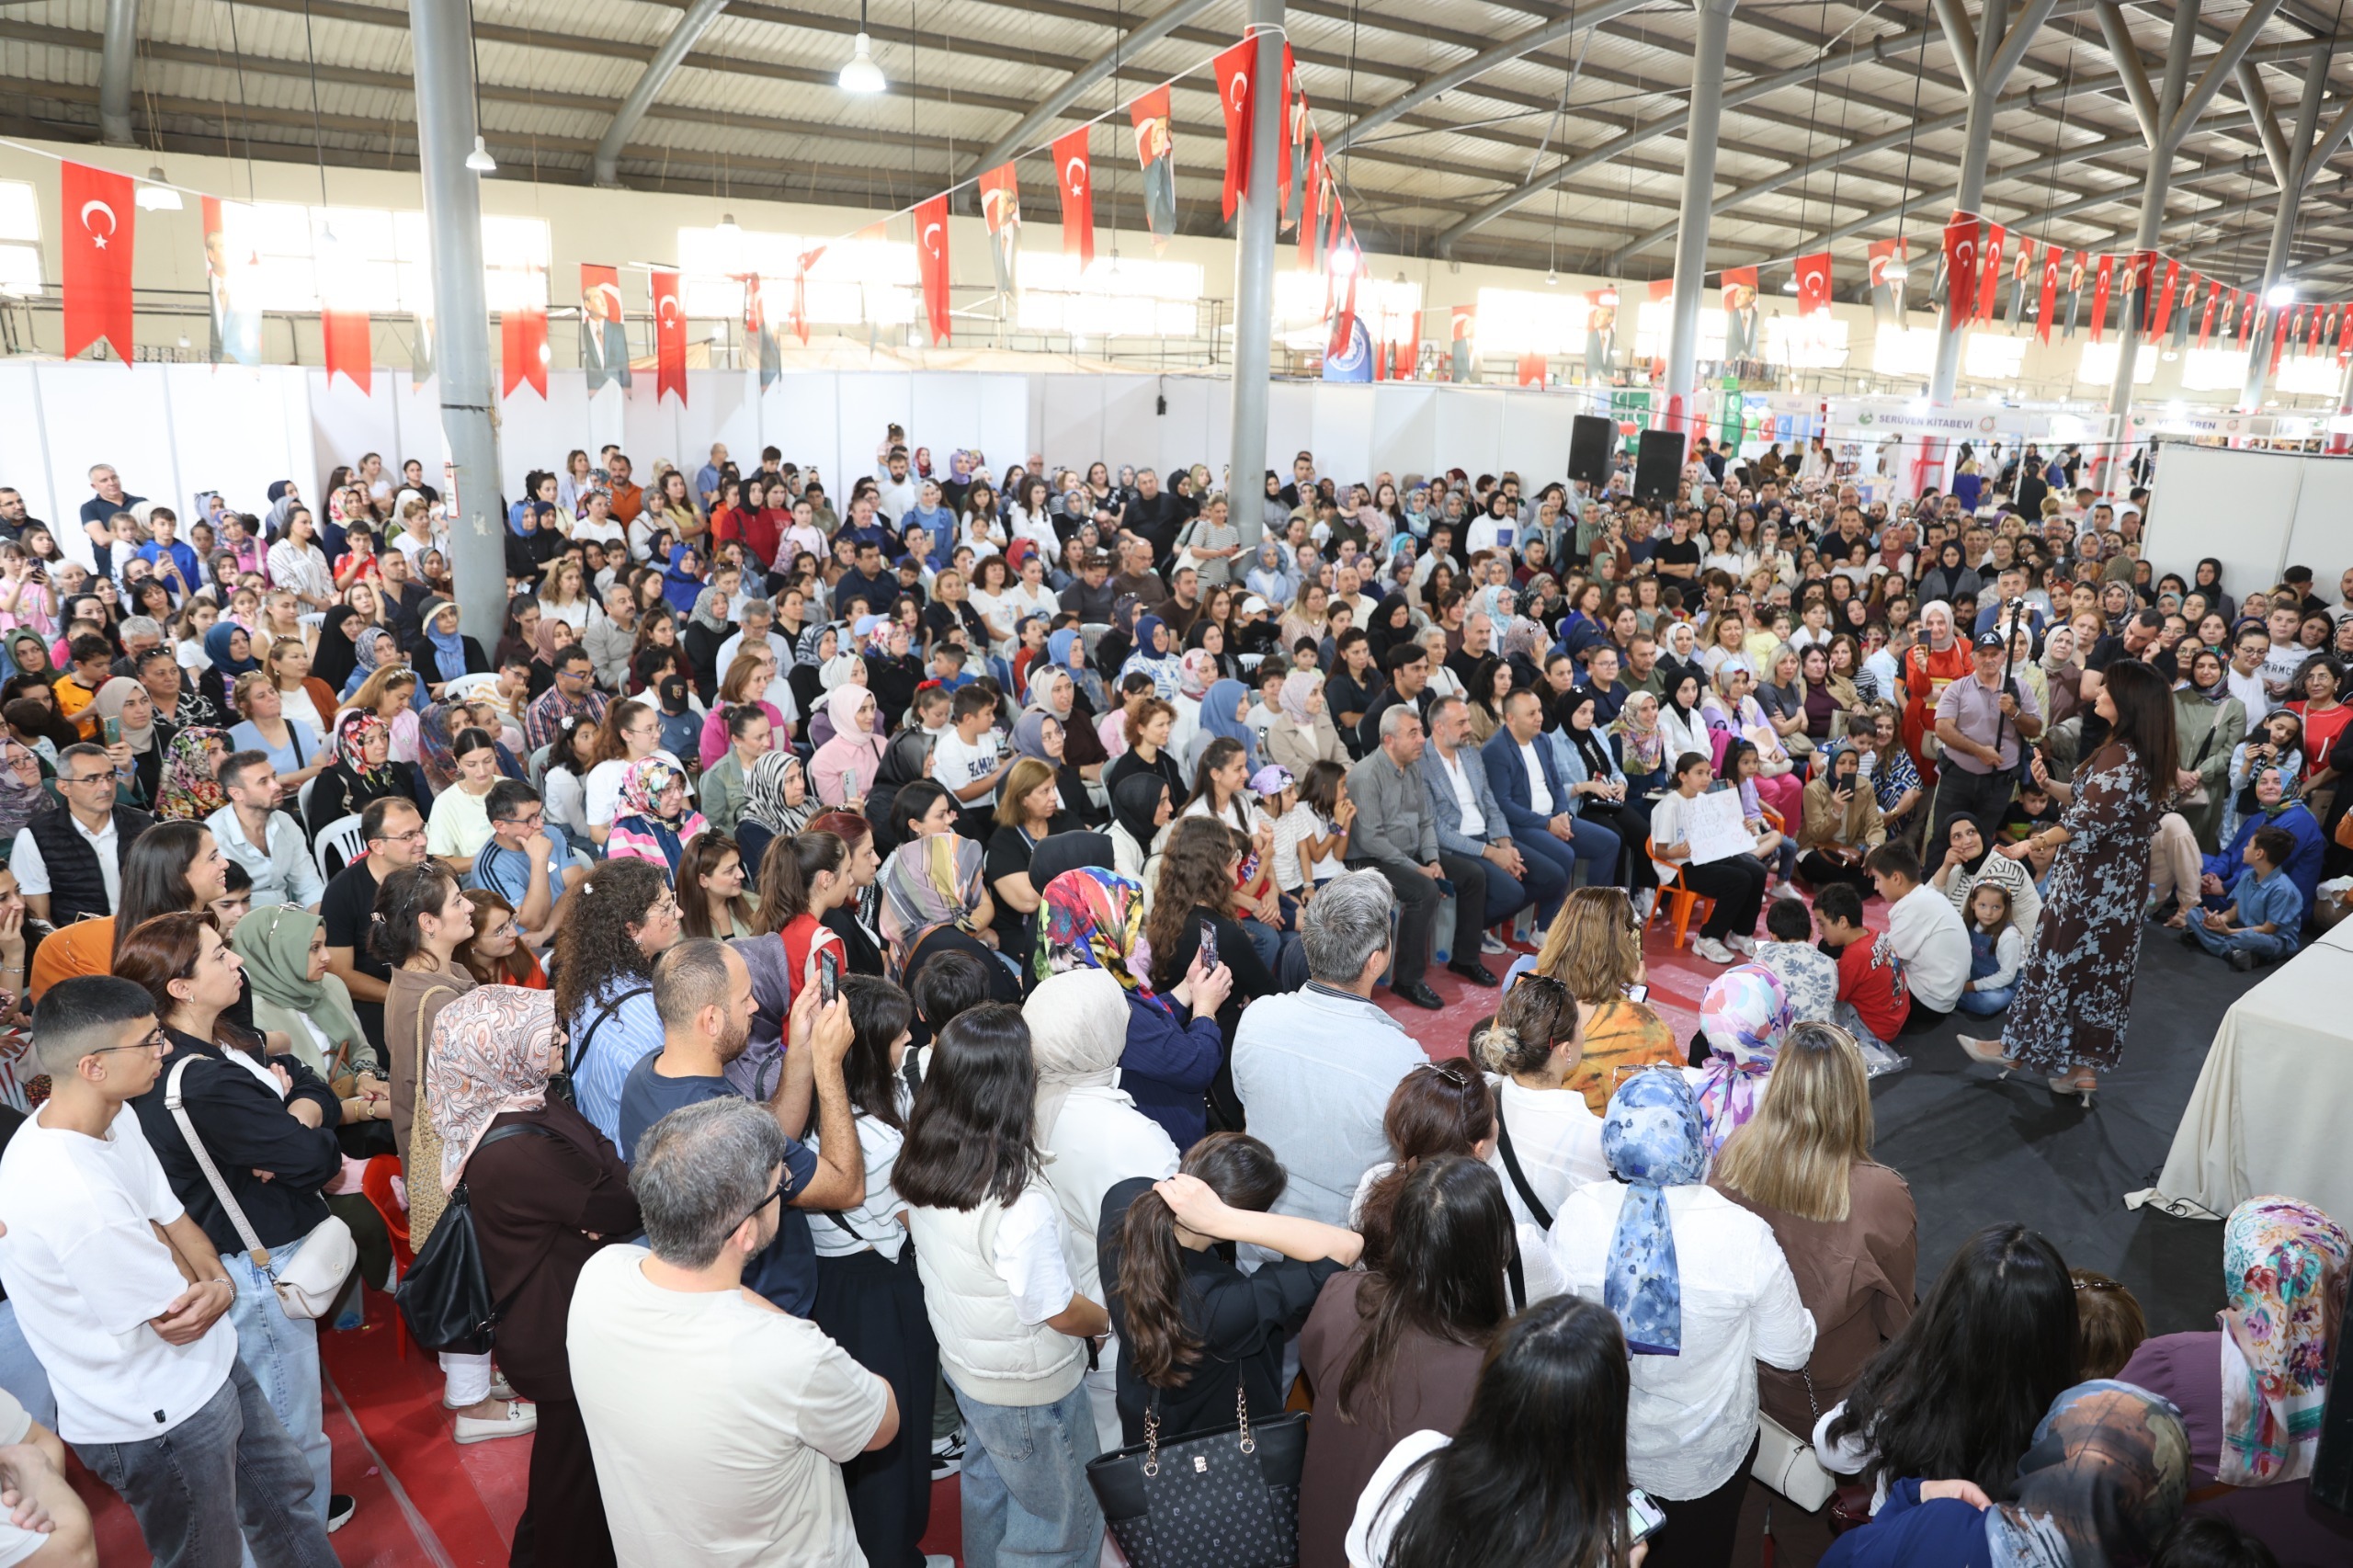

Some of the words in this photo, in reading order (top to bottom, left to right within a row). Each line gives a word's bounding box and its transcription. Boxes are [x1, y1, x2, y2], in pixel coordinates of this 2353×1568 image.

[1879, 415, 1925, 427] SERÜVEN
[1927, 416, 1974, 430] KİTABEVİ
[185, 1127, 206, 1159] UNITED
[203, 1160, 228, 1198] COLORS
[223, 1197, 236, 1211] OF
[229, 1210, 260, 1251] BENETTO
